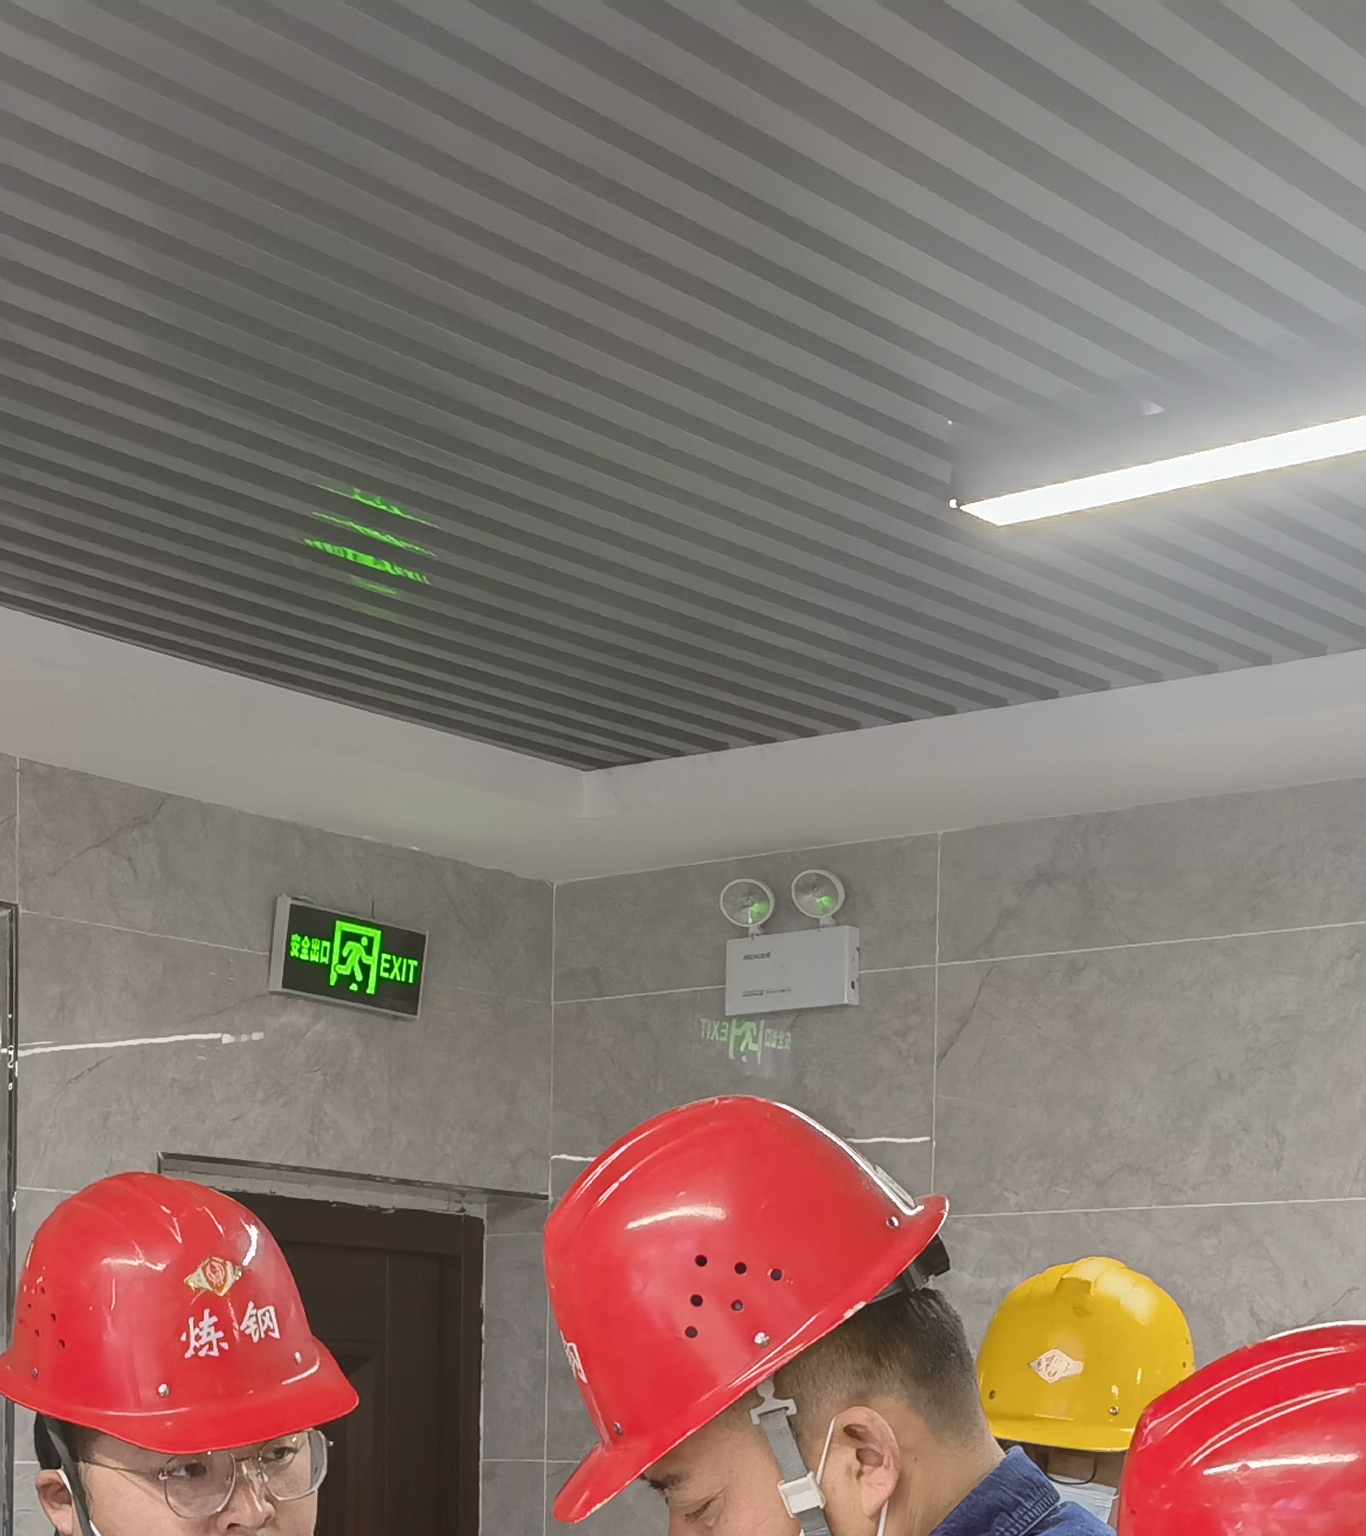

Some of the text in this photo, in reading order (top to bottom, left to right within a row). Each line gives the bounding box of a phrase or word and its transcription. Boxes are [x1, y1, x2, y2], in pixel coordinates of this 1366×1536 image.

[290, 933, 419, 983] 安全出口 EXIT
[180, 1301, 280, 1358] 炼钢
